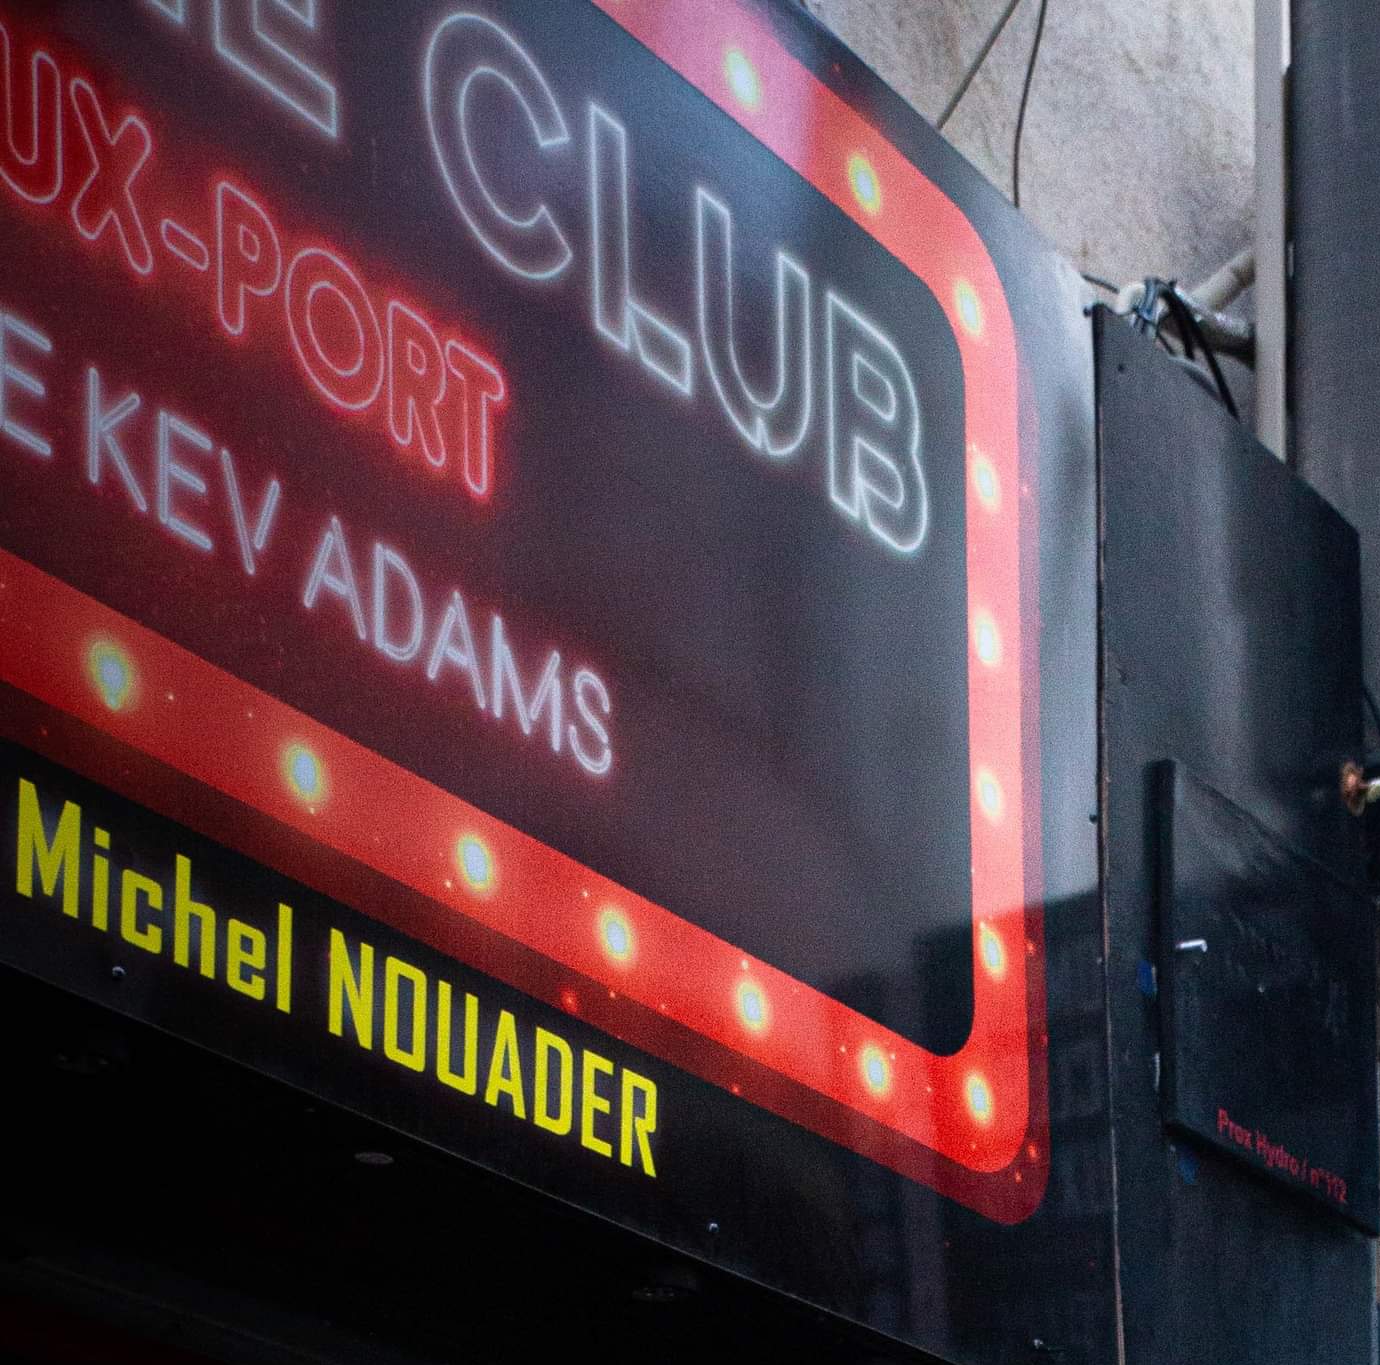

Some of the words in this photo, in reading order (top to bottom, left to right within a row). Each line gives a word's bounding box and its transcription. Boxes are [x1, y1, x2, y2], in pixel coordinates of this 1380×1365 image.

[423, 9, 930, 555] CLUB
[87, 367, 280, 575] KEV
[303, 515, 614, 776] ADAMS
[15, 779, 293, 1013] Michel
[328, 927, 660, 1178] NOUADER
